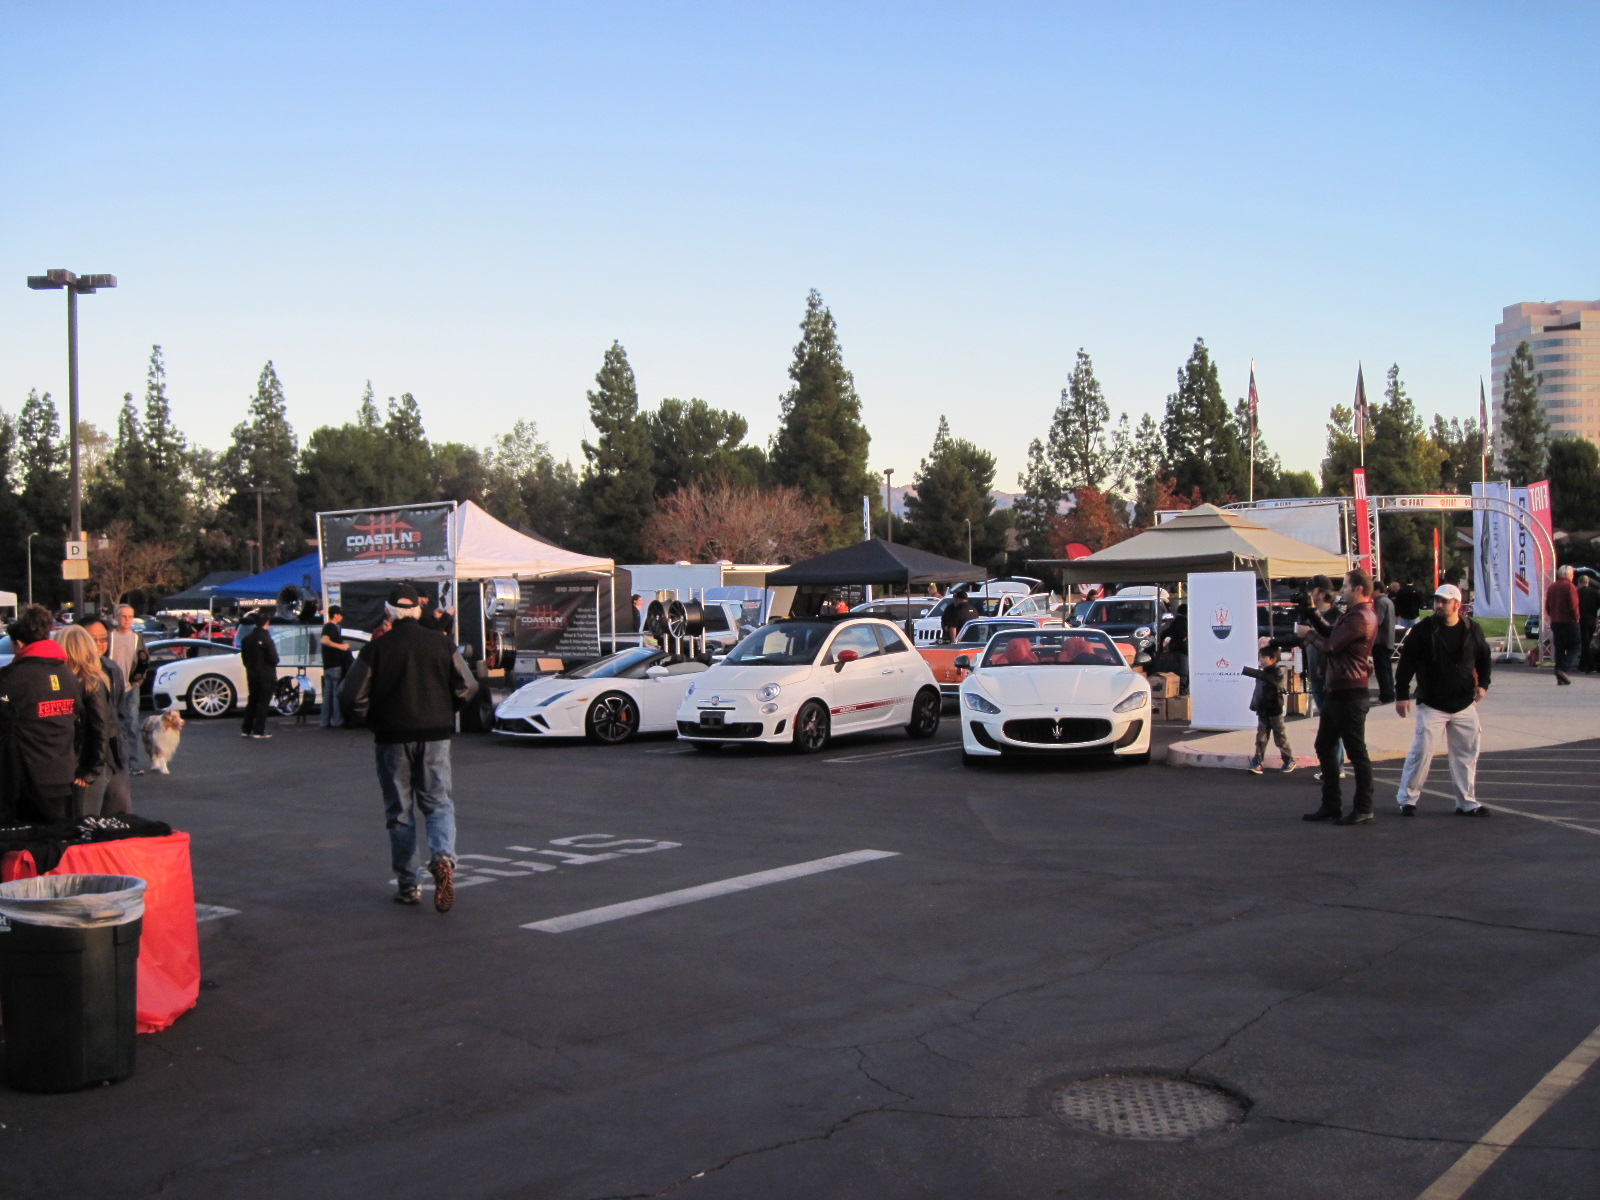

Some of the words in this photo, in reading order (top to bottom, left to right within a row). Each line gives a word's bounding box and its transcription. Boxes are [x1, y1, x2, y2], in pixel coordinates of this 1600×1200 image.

[1409, 498, 1425, 506] FIAT
[71, 545, 80, 556] D
[38, 699, 75, 714] Ferrari
